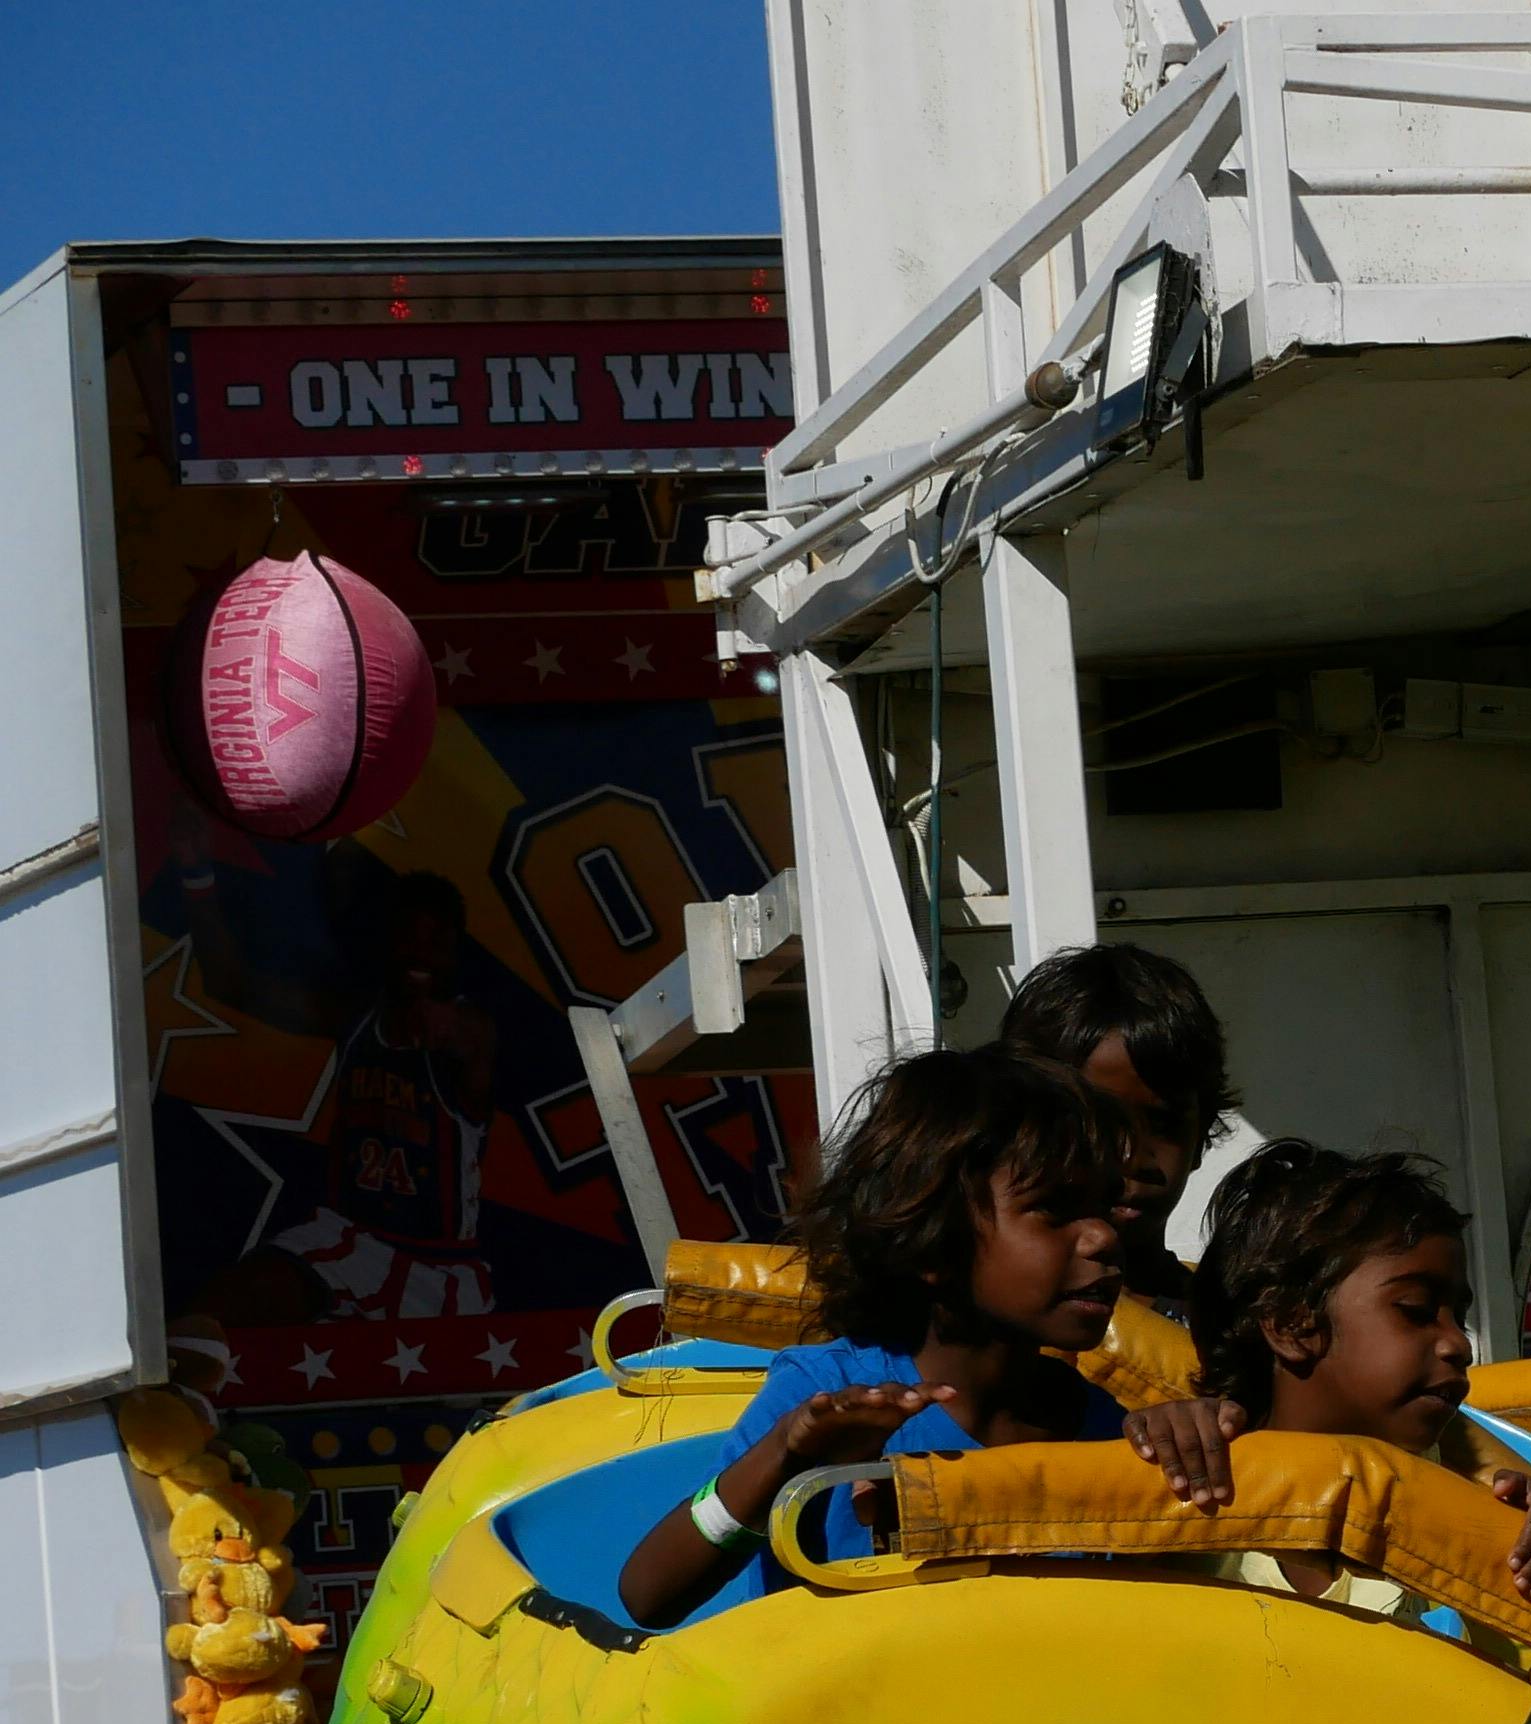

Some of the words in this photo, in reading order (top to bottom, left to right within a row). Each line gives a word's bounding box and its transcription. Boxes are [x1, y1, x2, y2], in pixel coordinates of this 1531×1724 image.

[290, 357, 459, 428] ONE
[485, 355, 579, 425] IN
[604, 351, 793, 422] WIN
[208, 656, 296, 811] VIRGINIA
[266, 626, 320, 745] VT
